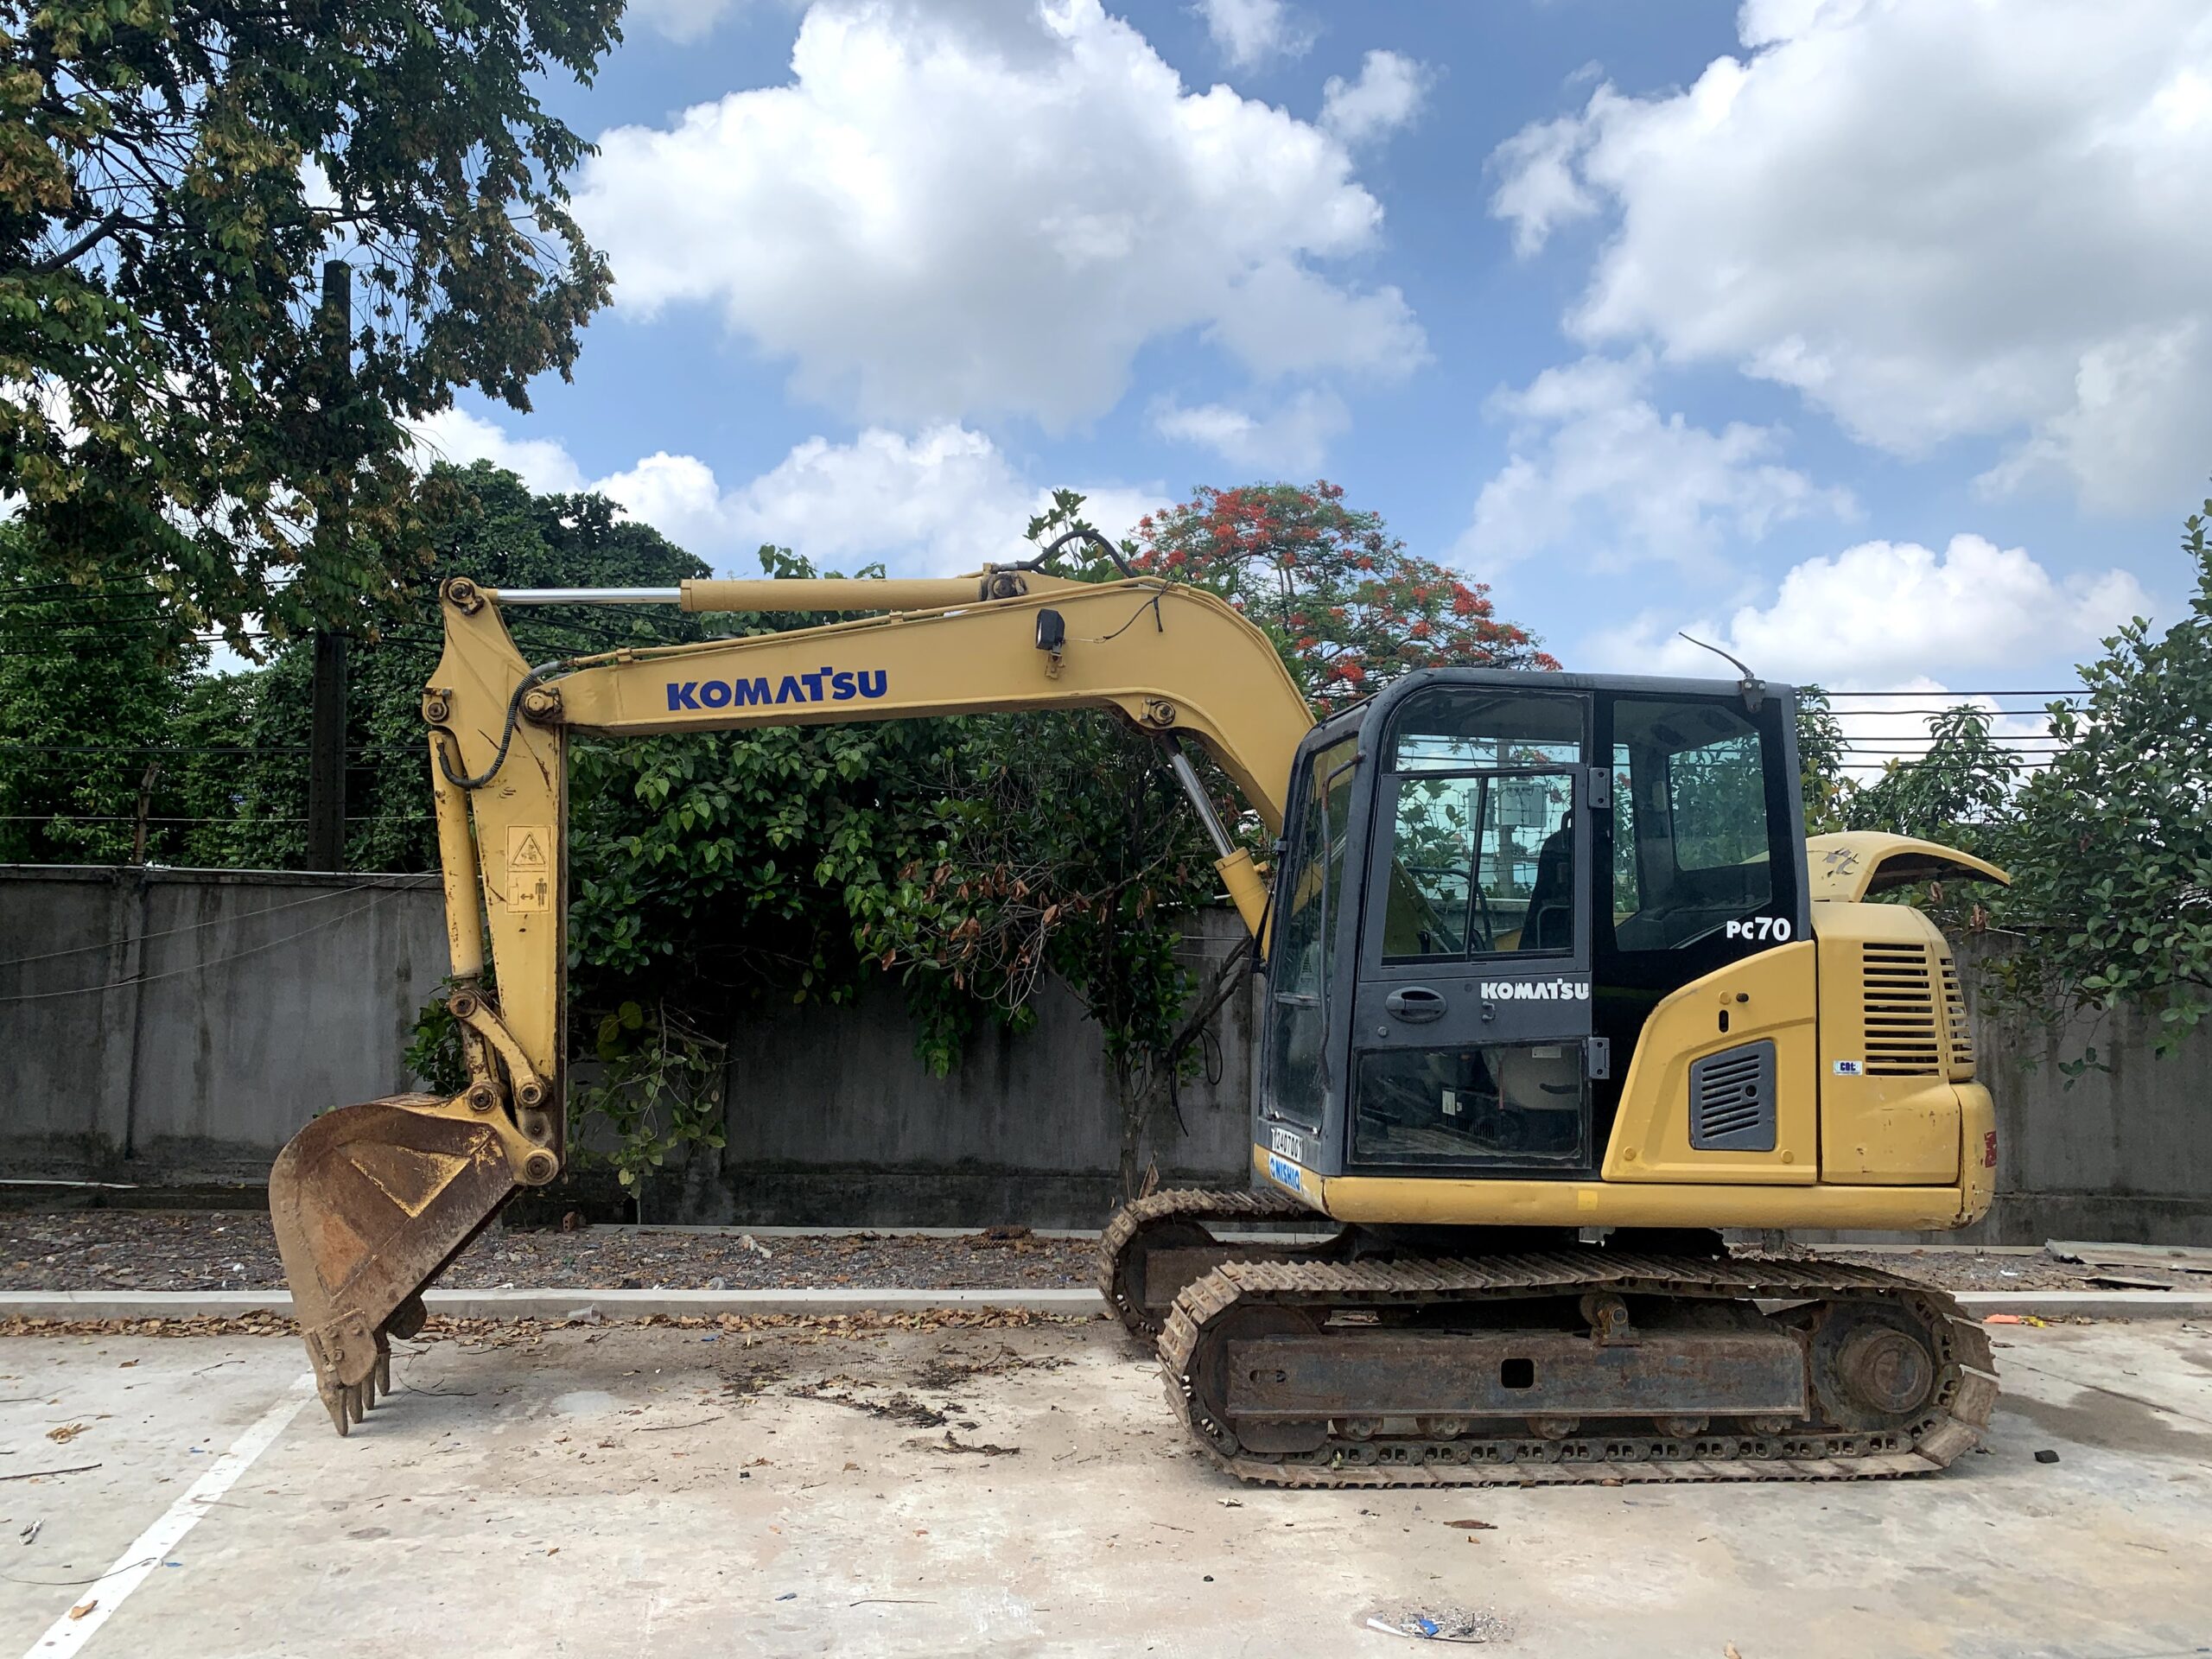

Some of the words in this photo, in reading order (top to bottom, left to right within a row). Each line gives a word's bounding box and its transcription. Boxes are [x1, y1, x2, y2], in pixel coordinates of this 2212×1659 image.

[666, 666, 887, 711] KOMATSU
[1726, 917, 1791, 942] PC70
[1480, 978, 1590, 1000] KOMATSU
